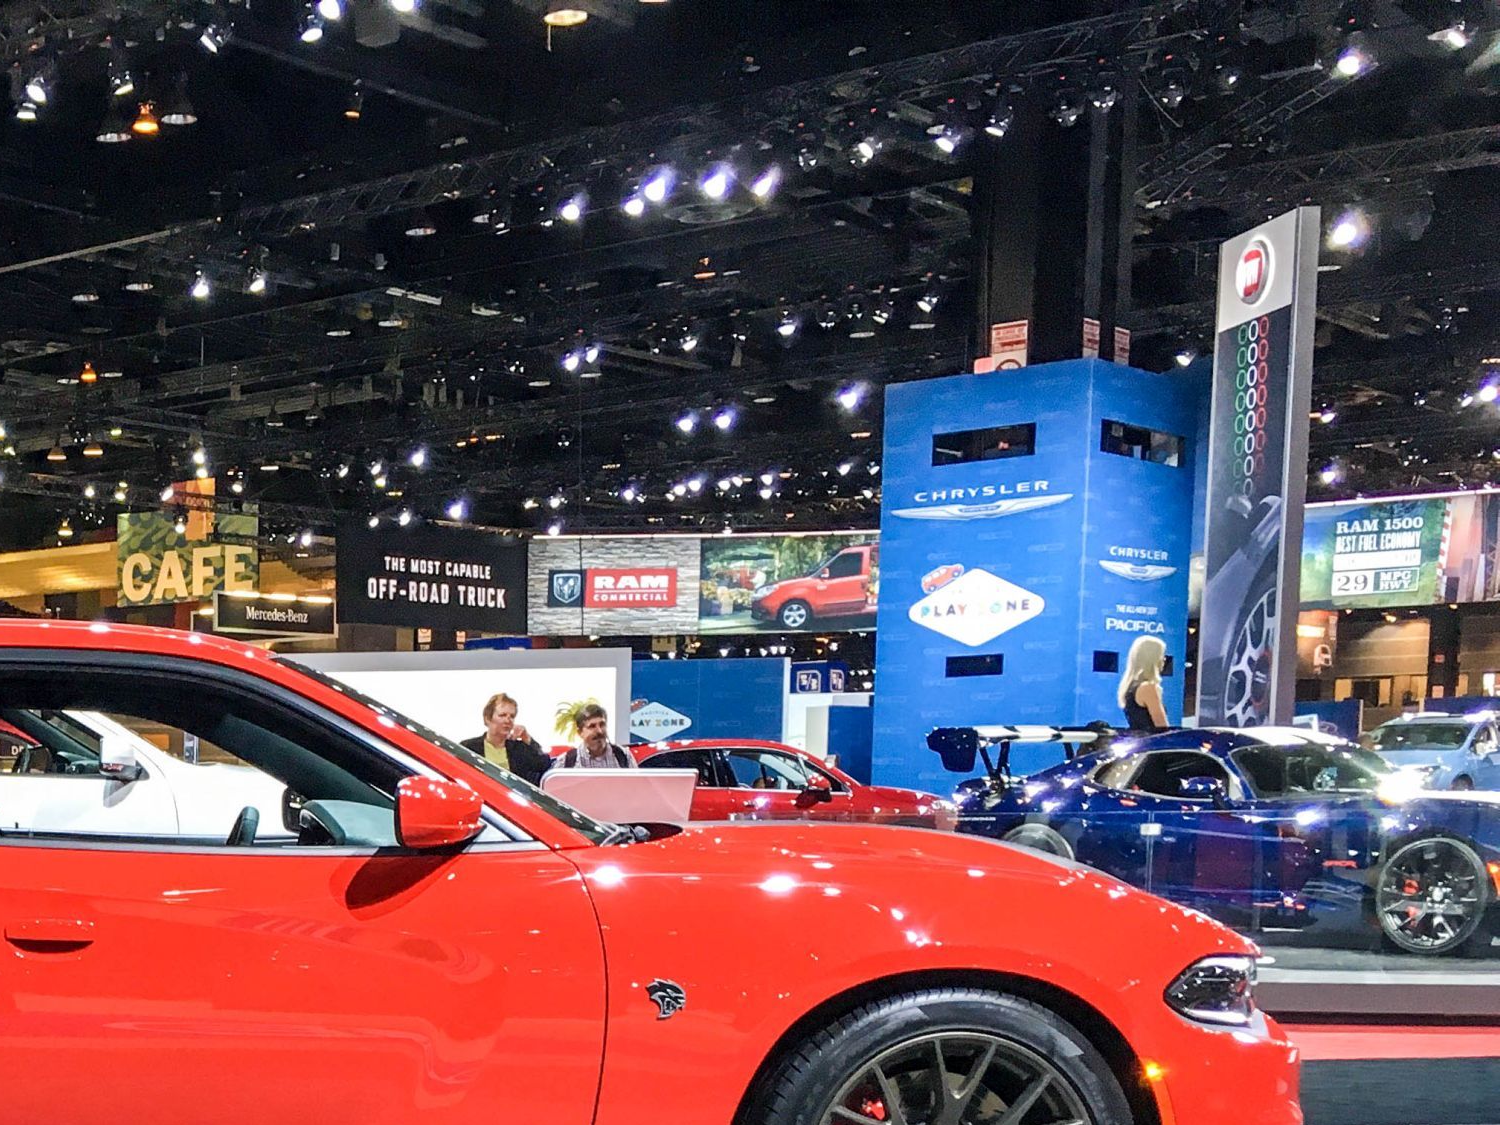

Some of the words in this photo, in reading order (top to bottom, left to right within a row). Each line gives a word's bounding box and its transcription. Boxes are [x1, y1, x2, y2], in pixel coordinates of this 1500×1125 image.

[913, 480, 1049, 502] CHRYSLER
[1336, 519, 1380, 535] RAM
[1384, 516, 1424, 531] 1500
[1335, 534, 1358, 554] BEST
[1358, 533, 1378, 552] FUEL
[1380, 530, 1422, 551] ECONOMY
[1109, 545, 1169, 560] CHRYSLER
[122, 544, 253, 603] CAFE
[384, 555, 406, 572] THE
[410, 558, 441, 576] MOST
[445, 561, 492, 580] CAPABLE
[593, 575, 670, 589] RAM
[1337, 574, 1368, 592] 29
[1379, 571, 1412, 581] MPG
[1379, 579, 1412, 591] HWY
[367, 577, 450, 605] OFF-ROAD
[457, 584, 506, 609] TRUCK
[593, 593, 669, 602] COMMERCIAL
[245, 605, 309, 624] Mercedes-Benz
[921, 603, 967, 618] PLAY
[1106, 617, 1165, 633] PACIFICA
[631, 719, 651, 727] LAY
[655, 718, 685, 727] ZONE
